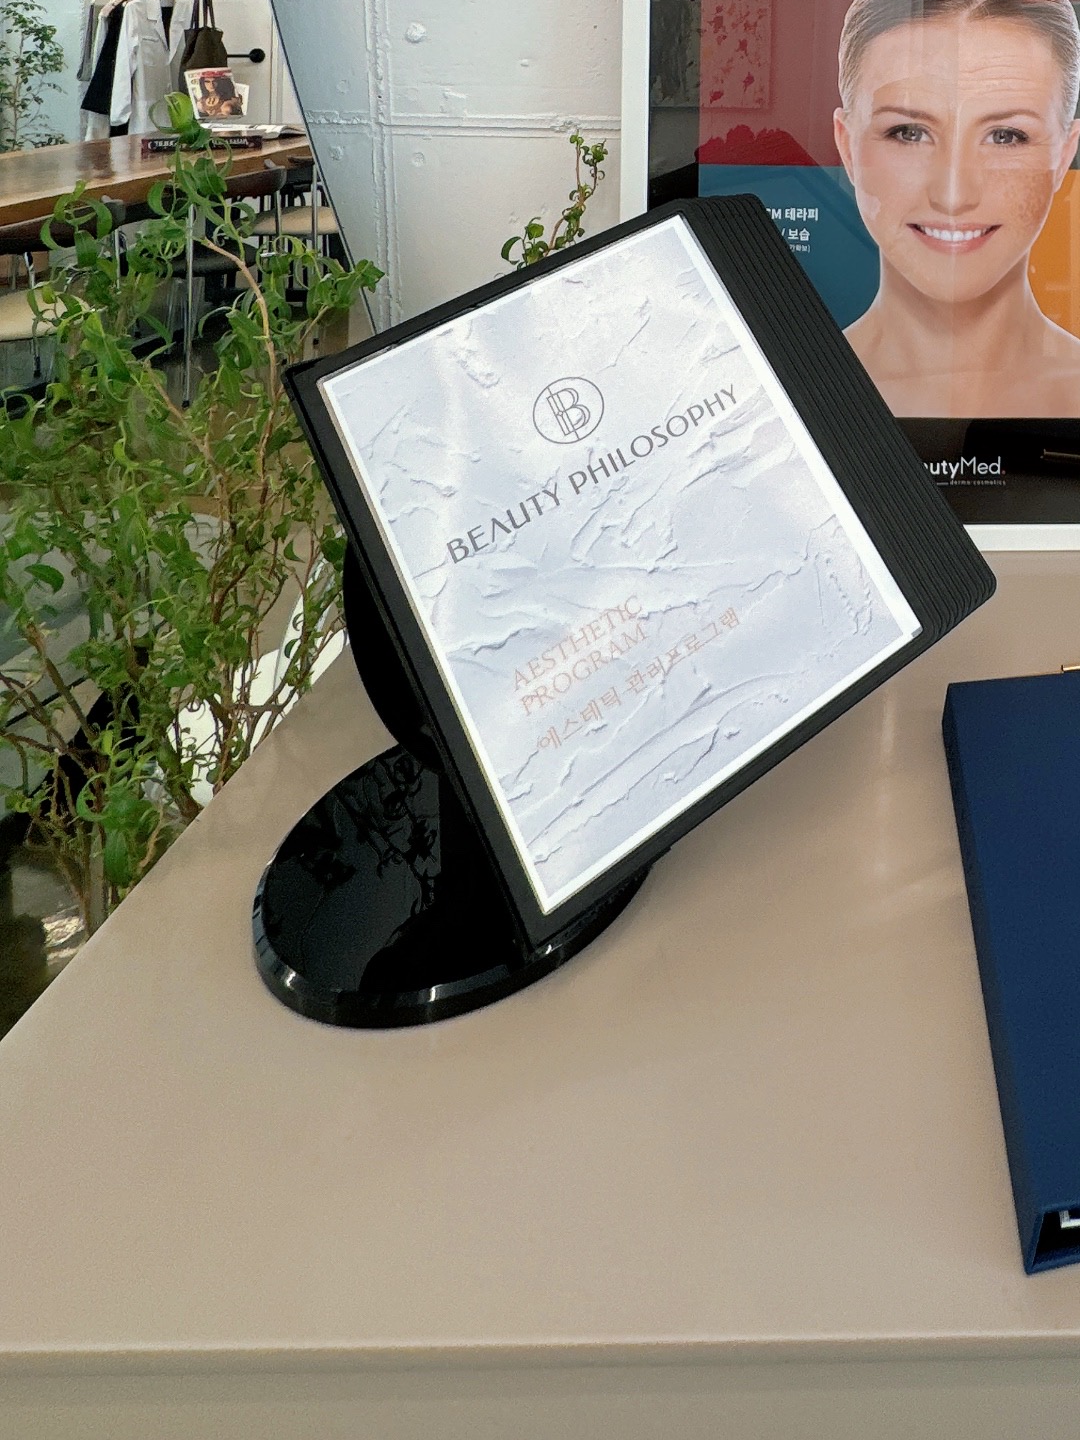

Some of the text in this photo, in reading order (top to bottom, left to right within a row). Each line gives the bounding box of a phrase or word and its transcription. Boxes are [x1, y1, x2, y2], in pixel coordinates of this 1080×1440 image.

[785, 207, 819, 221] 테라피
[788, 228, 810, 241] 보습
[446, 384, 737, 563] BEAUTY PHILOSOPHY
[514, 595, 642, 691] AESTHETIC
[519, 623, 650, 716] PROGRAM
[536, 607, 740, 749] 에스테틱 관리프로그램
